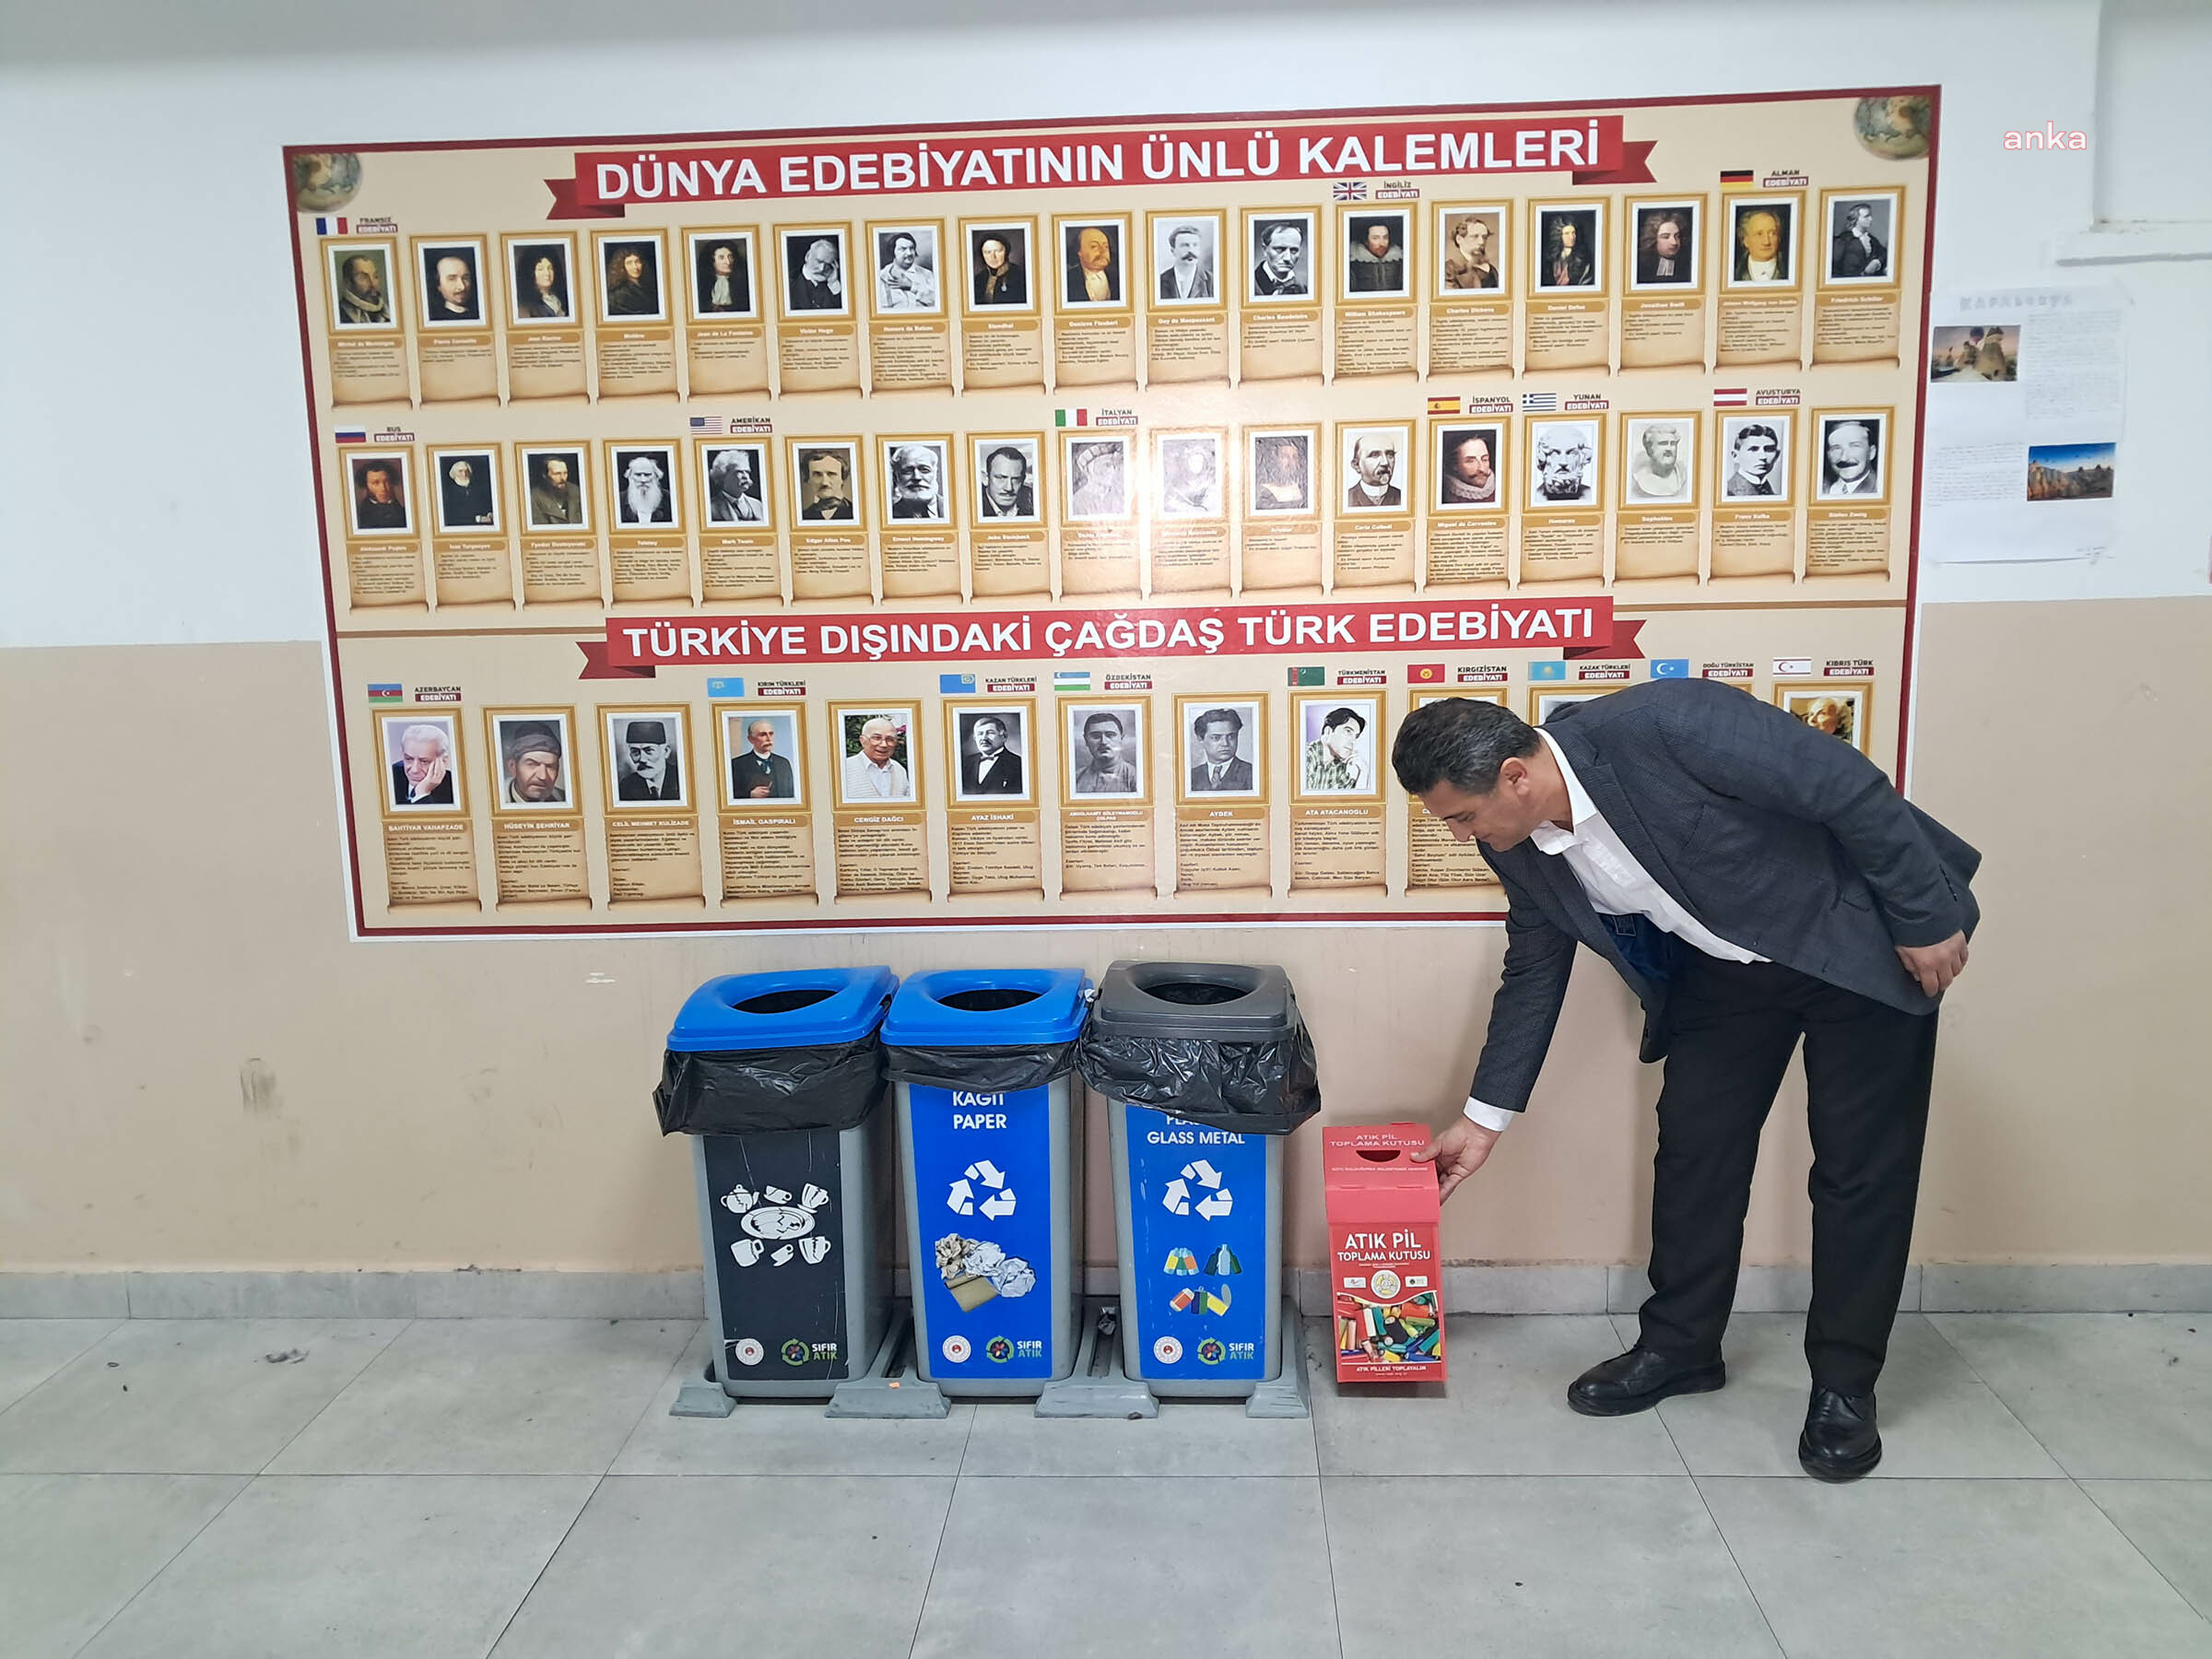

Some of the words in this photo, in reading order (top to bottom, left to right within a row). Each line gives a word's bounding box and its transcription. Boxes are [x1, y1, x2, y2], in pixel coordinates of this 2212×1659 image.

[596, 155, 767, 200] DÜNYA
[780, 143, 1123, 193] EDEBİYATININ
[1142, 131, 1281, 180] ÜNLÜ
[1299, 120, 1599, 174] KALEMLERİ
[1472, 395, 1512, 404] İSPANYOL
[1573, 393, 1602, 401] YUNAN
[731, 415, 771, 424] AMERİKAN
[623, 619, 806, 657] TÜRKİYE
[821, 615, 1030, 661] DIŞINDAKİ
[1045, 612, 1224, 657] ÇAĞDAŞ
[1238, 609, 1357, 646] TÜRK
[1371, 603, 1593, 642] EDEBİYATI
[953, 1113, 1007, 1129] PAPER
[1147, 1131, 1194, 1145] GLASS
[1199, 1131, 1246, 1145] METAL
[1345, 1232, 1386, 1249] ATIK
[1393, 1228, 1422, 1249] PİL
[1337, 1251, 1386, 1262] TOPLAMA
[1389, 1250, 1430, 1261] KUTUSU
[812, 1343, 838, 1352] SIFIR
[1017, 1340, 1042, 1349] SIFIR
[1229, 1342, 1254, 1351] SIFIR
[813, 1351, 838, 1360] ATIK
[1018, 1348, 1042, 1358] ATIK
[1230, 1350, 1254, 1359] ATIK
